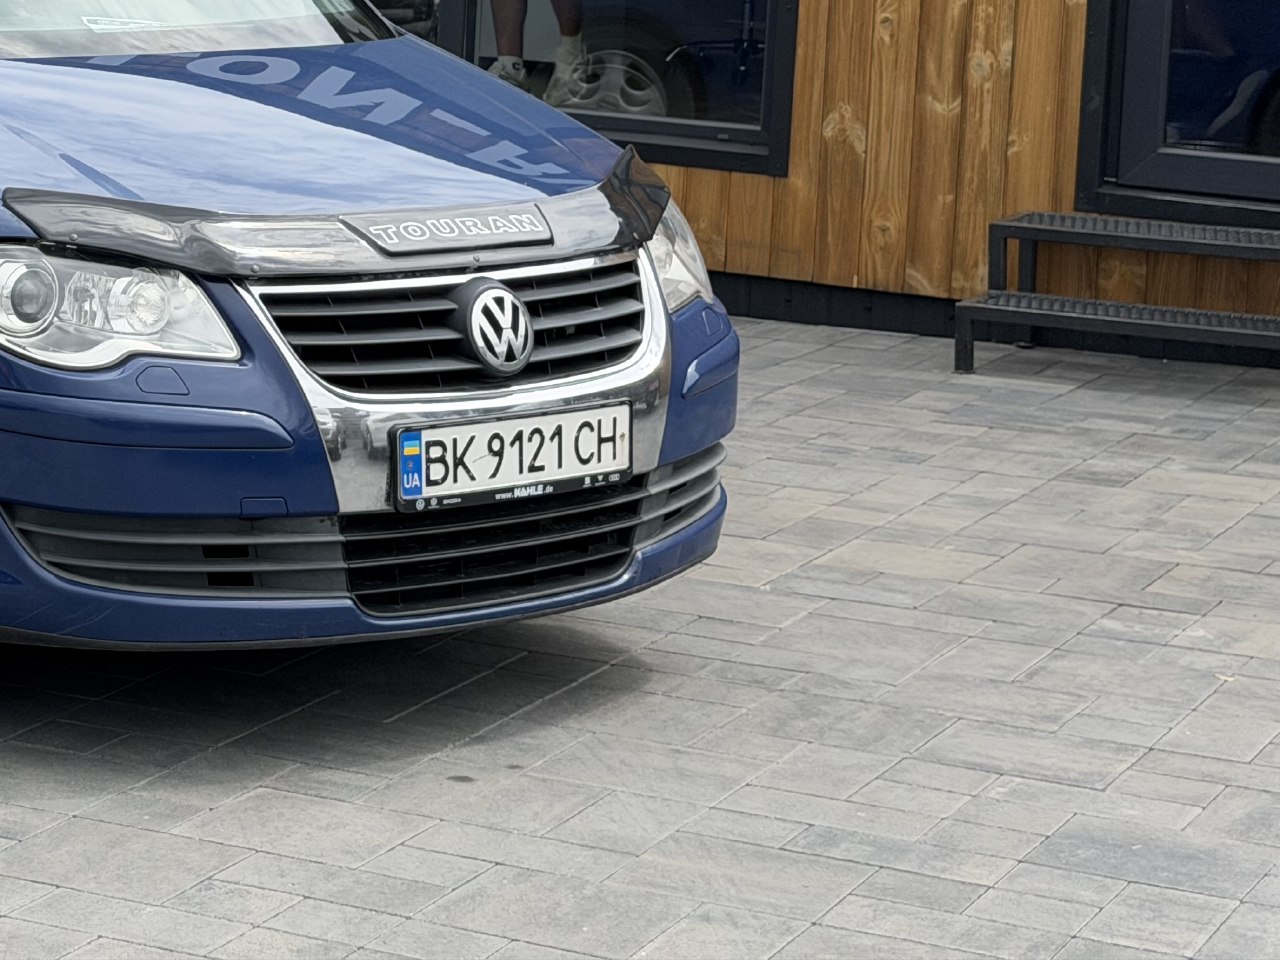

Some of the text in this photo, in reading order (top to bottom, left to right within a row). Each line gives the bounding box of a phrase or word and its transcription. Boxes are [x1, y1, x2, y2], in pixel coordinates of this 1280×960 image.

[369, 213, 544, 245] TOURAN
[425, 416, 616, 487] BK 9121 CH
[403, 472, 421, 489] UA
